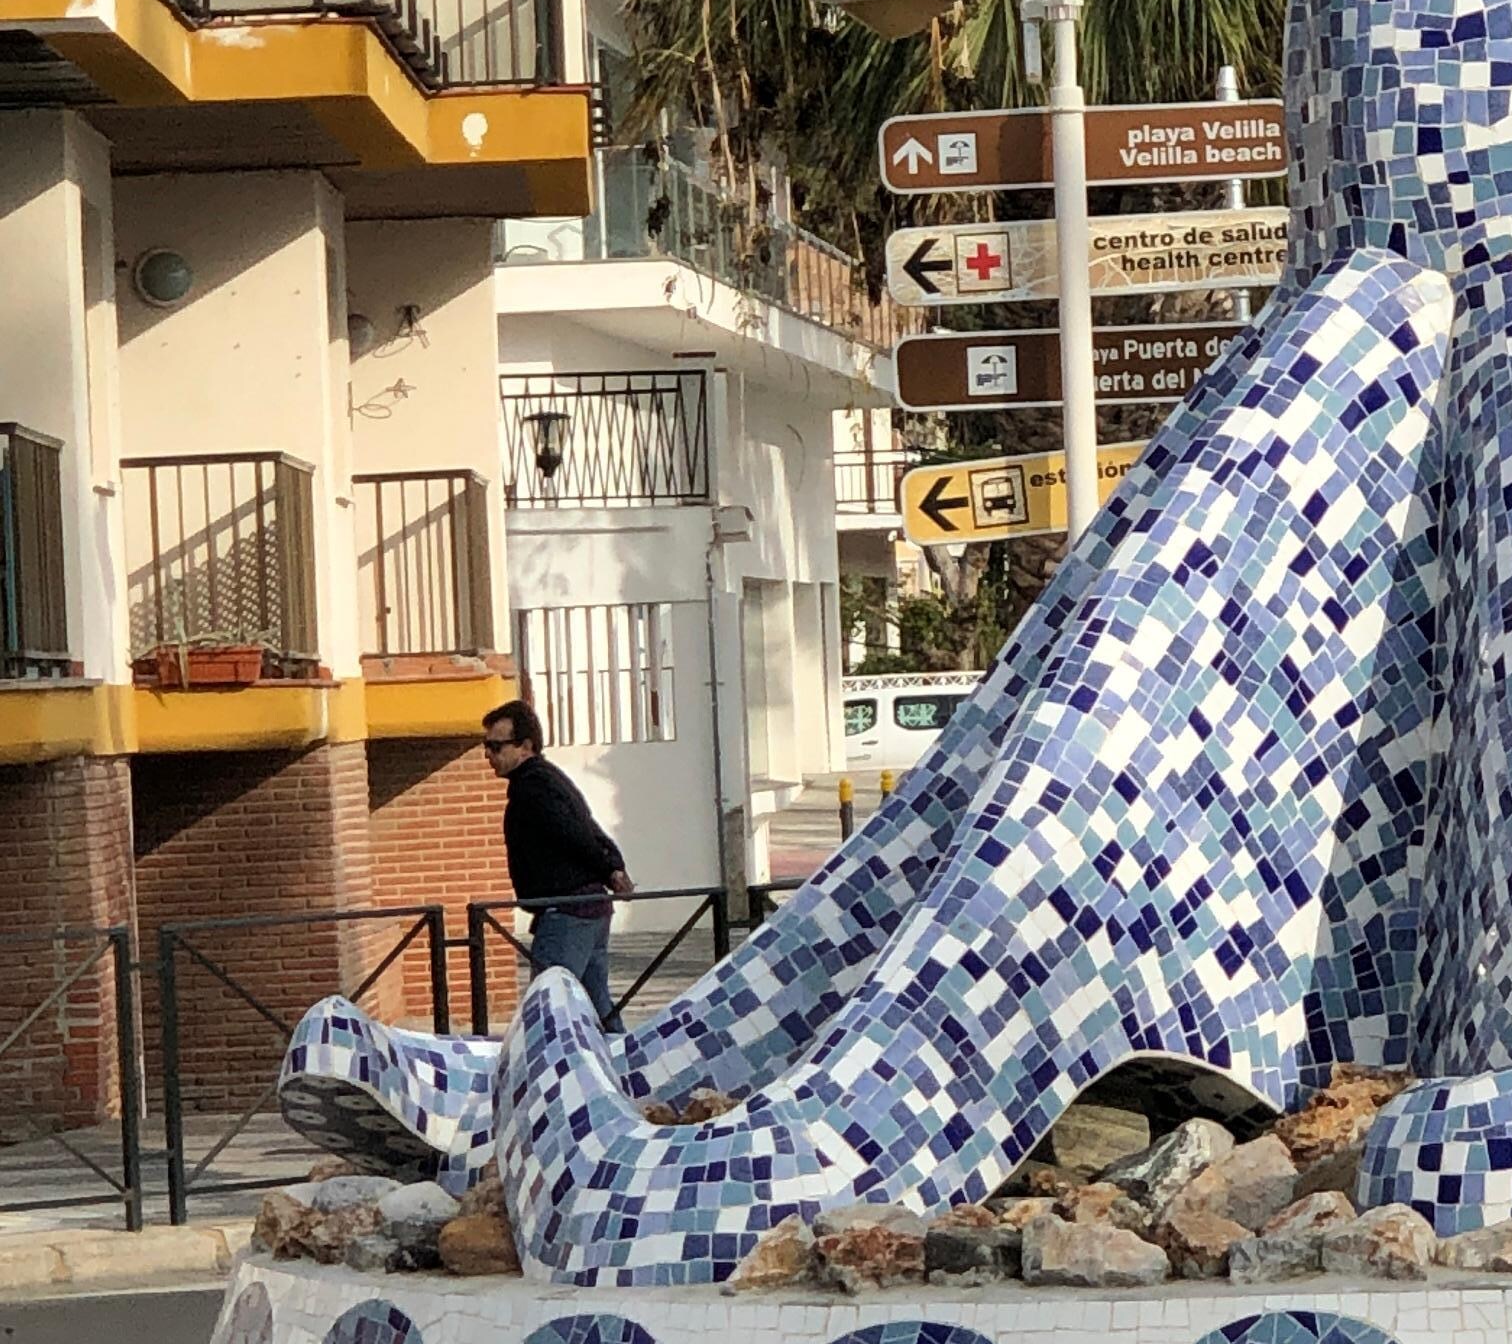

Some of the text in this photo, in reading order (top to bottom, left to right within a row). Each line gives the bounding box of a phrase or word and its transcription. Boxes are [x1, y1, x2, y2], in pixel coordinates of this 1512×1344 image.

[1128, 119, 1281, 147] playa Velilla
[1120, 142, 1282, 167] Velilla beach
[1093, 222, 1288, 250] centro de salud
[1121, 246, 1288, 271] health centre
[1093, 336, 1233, 365] aya Puerta de
[1094, 370, 1144, 393] erta
[1152, 368, 1185, 390] del
[1030, 461, 1132, 488] estión
